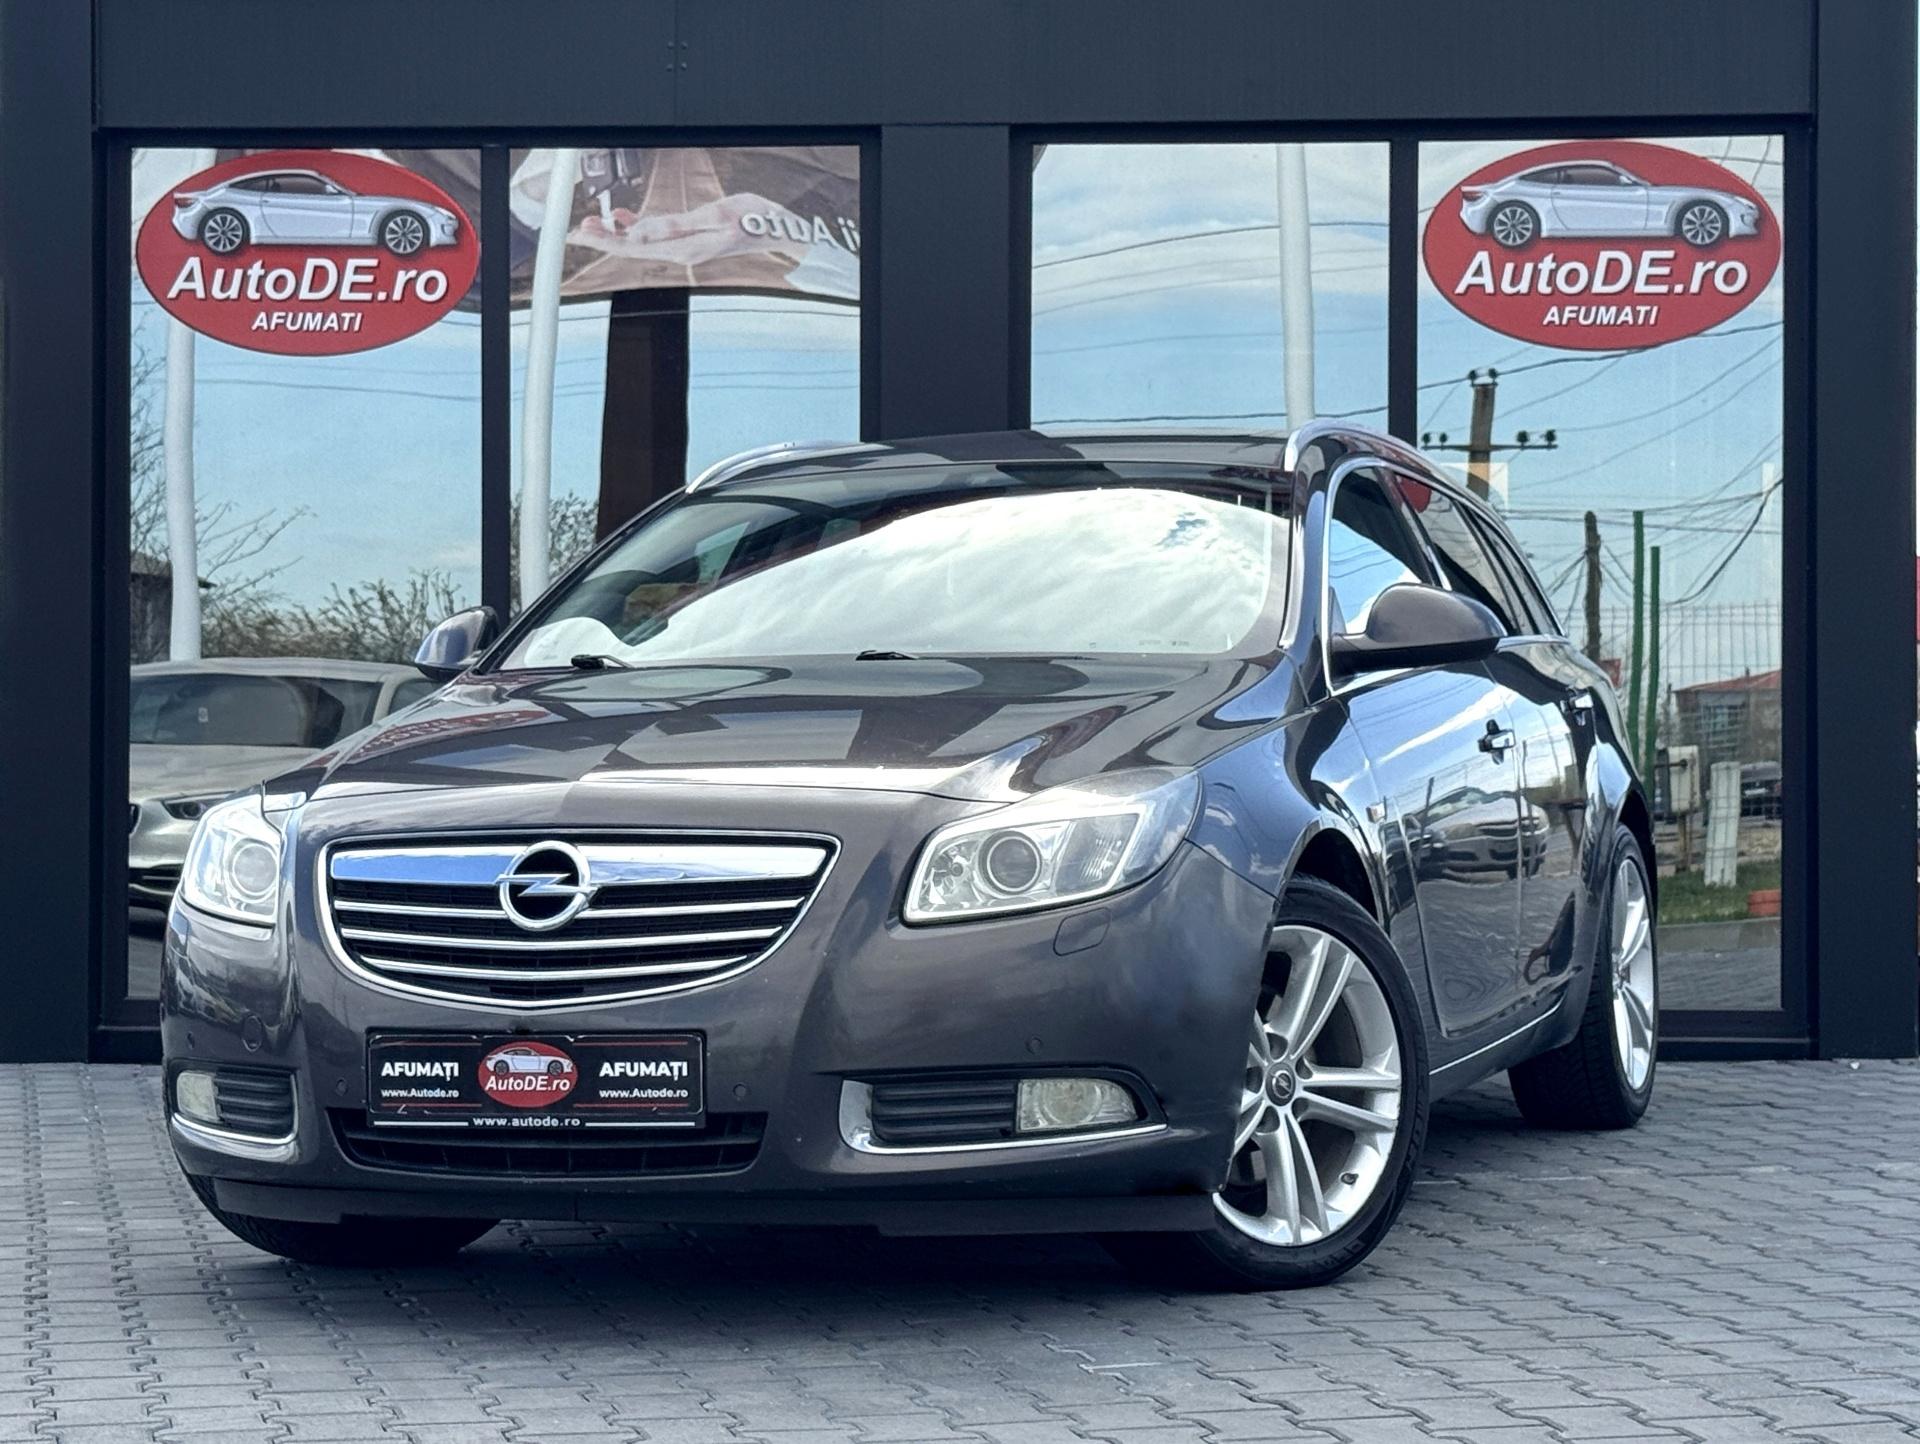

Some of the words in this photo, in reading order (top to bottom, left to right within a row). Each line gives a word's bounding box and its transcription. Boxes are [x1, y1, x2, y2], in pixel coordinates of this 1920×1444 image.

[167, 256, 449, 302] AutoDE.ro
[1454, 250, 1749, 295] AutoDE.ro
[251, 312, 364, 332] AFUMATI
[1542, 305, 1659, 326] AFUMATI
[485, 1075, 570, 1091] AutoDE.ro
[381, 1088, 460, 1098] www.Autode.ro
[599, 1088, 689, 1098] www.Autode.ro
[473, 1117, 581, 1127] www.autode.ro
